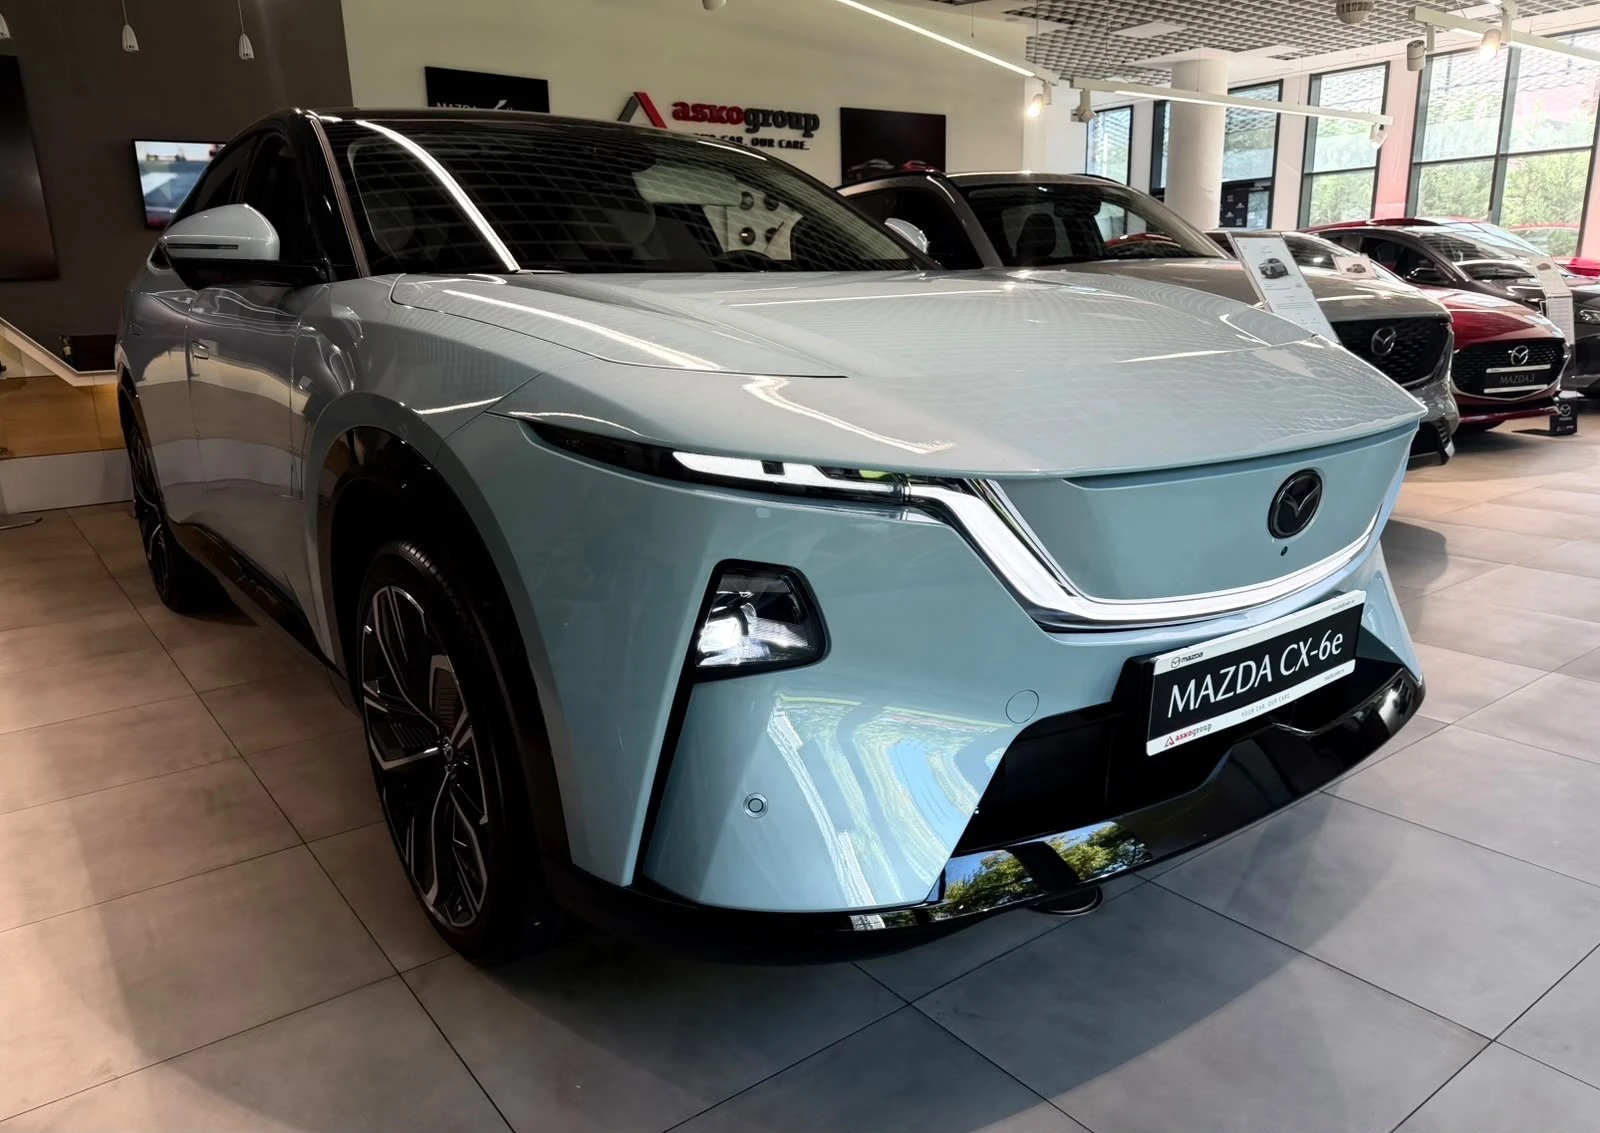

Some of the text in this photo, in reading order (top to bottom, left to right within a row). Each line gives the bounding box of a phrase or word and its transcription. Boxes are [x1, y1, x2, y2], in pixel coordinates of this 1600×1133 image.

[672, 102, 820, 138] askogroup
[751, 137, 774, 147] OUR
[1167, 630, 1344, 718] MAZDA CX-6e
